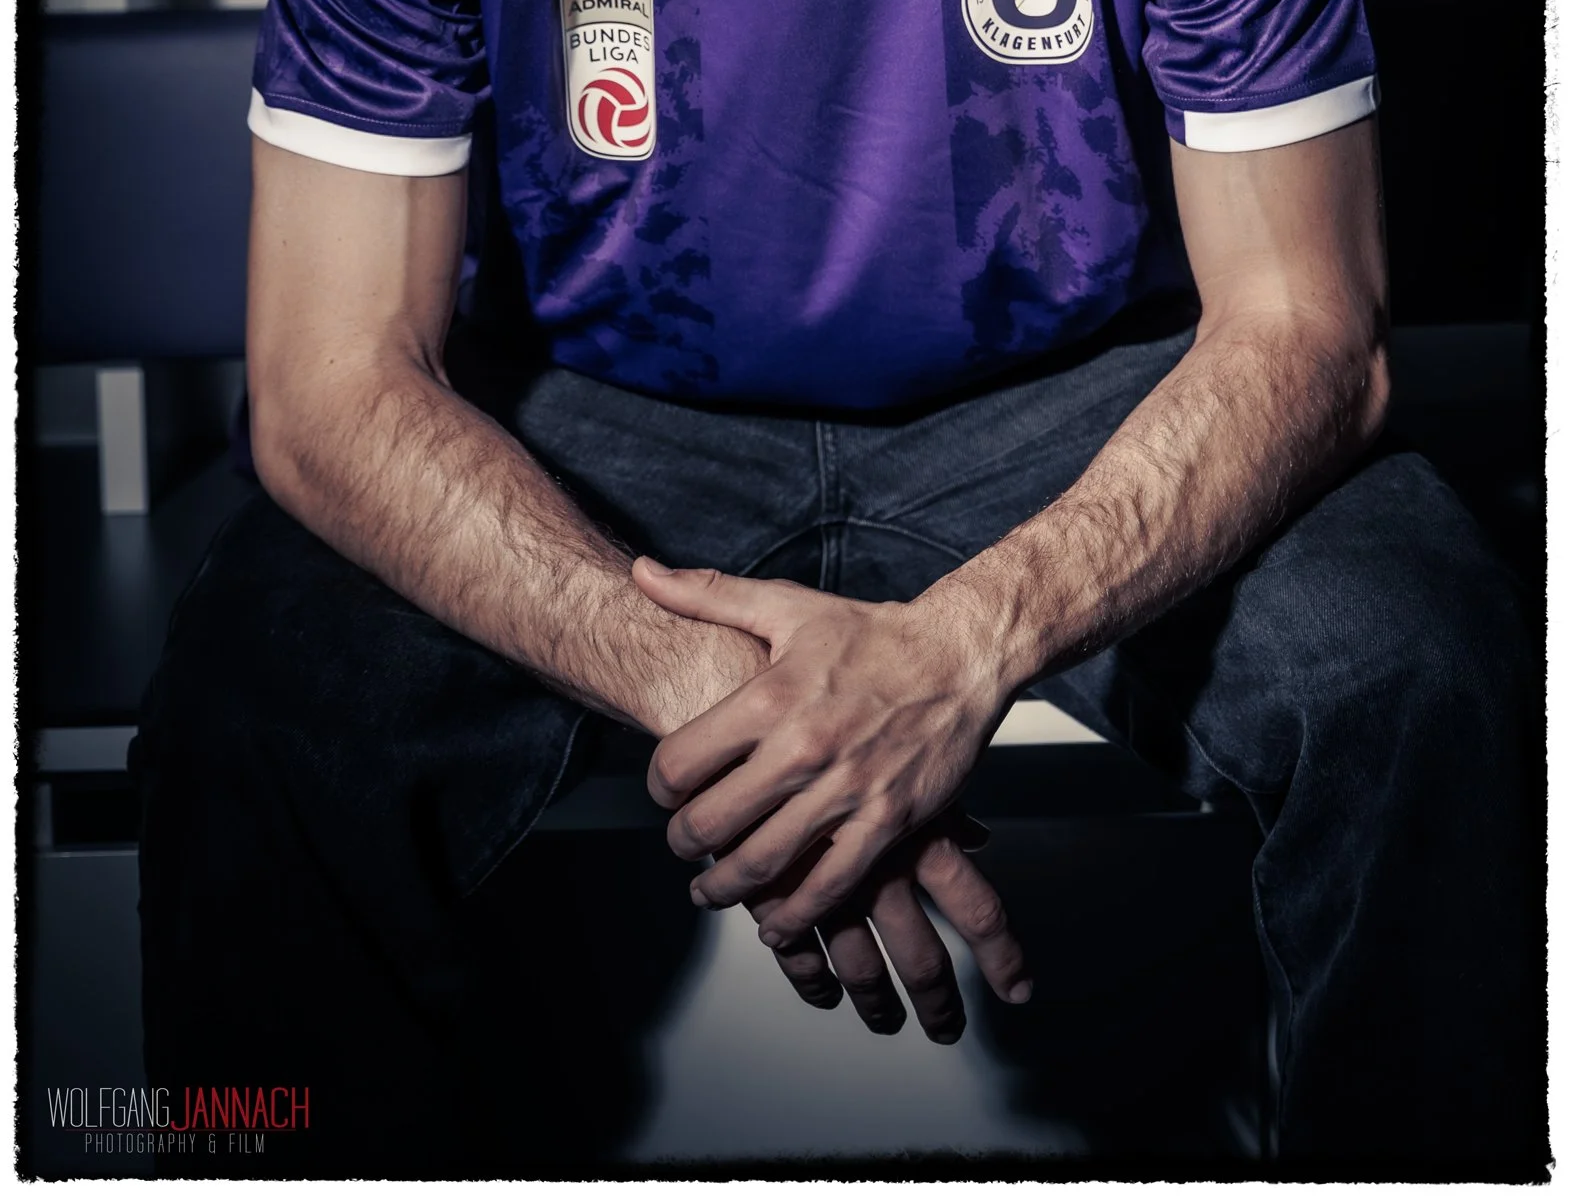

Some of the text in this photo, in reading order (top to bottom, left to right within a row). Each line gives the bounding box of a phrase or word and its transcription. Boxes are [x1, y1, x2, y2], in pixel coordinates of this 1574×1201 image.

[570, 28, 650, 52] BUNDES
[982, 14, 1086, 51] KLAGENFURT
[589, 46, 639, 64] LIGA
